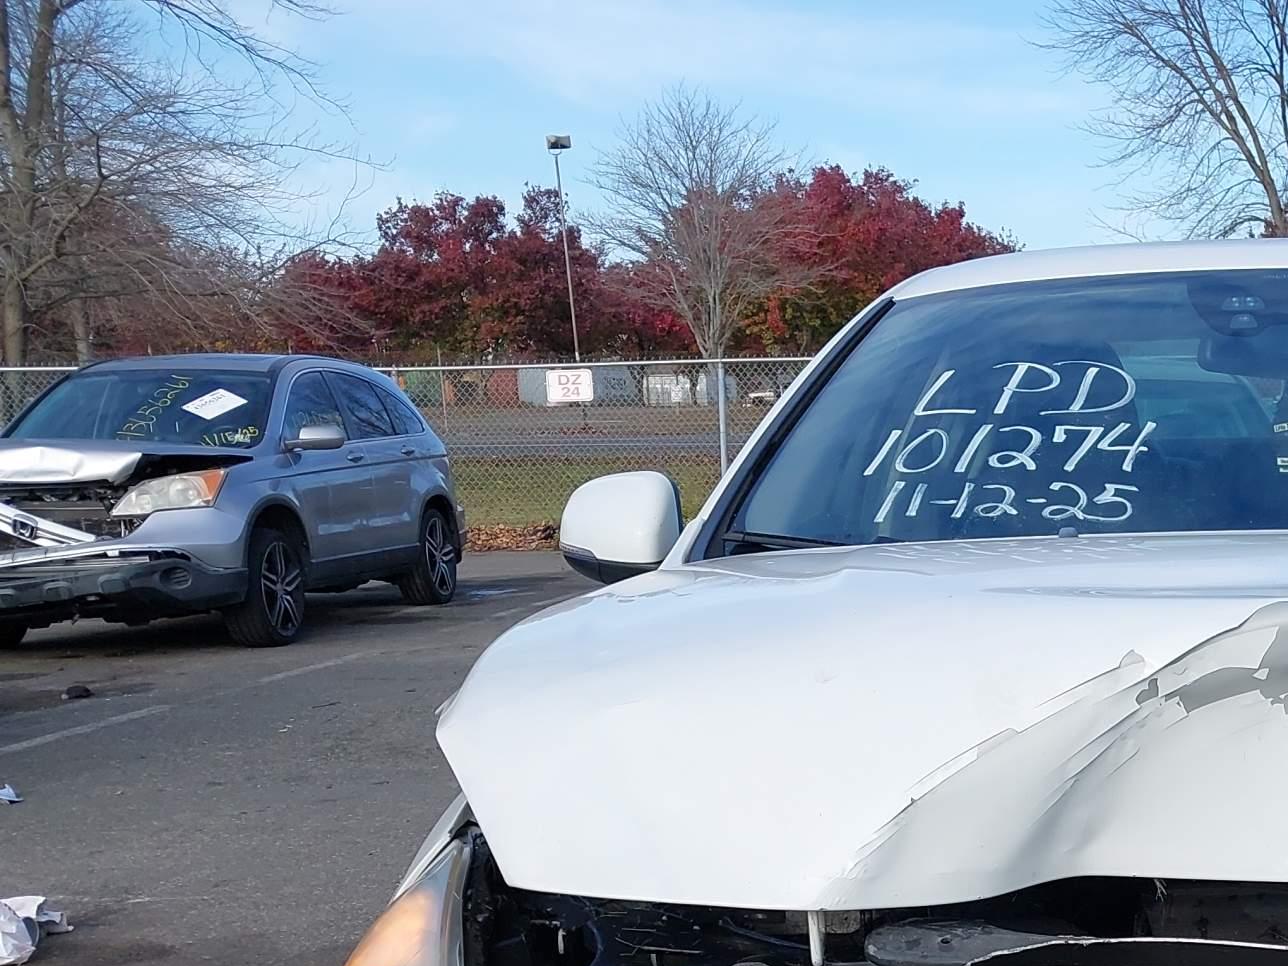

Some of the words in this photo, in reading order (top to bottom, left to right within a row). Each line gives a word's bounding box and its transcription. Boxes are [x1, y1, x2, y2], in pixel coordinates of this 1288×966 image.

[557, 374, 582, 386] DZ
[561, 387, 581, 398] 24
[863, 421, 1157, 476] 101274
[873, 481, 1139, 523] 11-12-25
